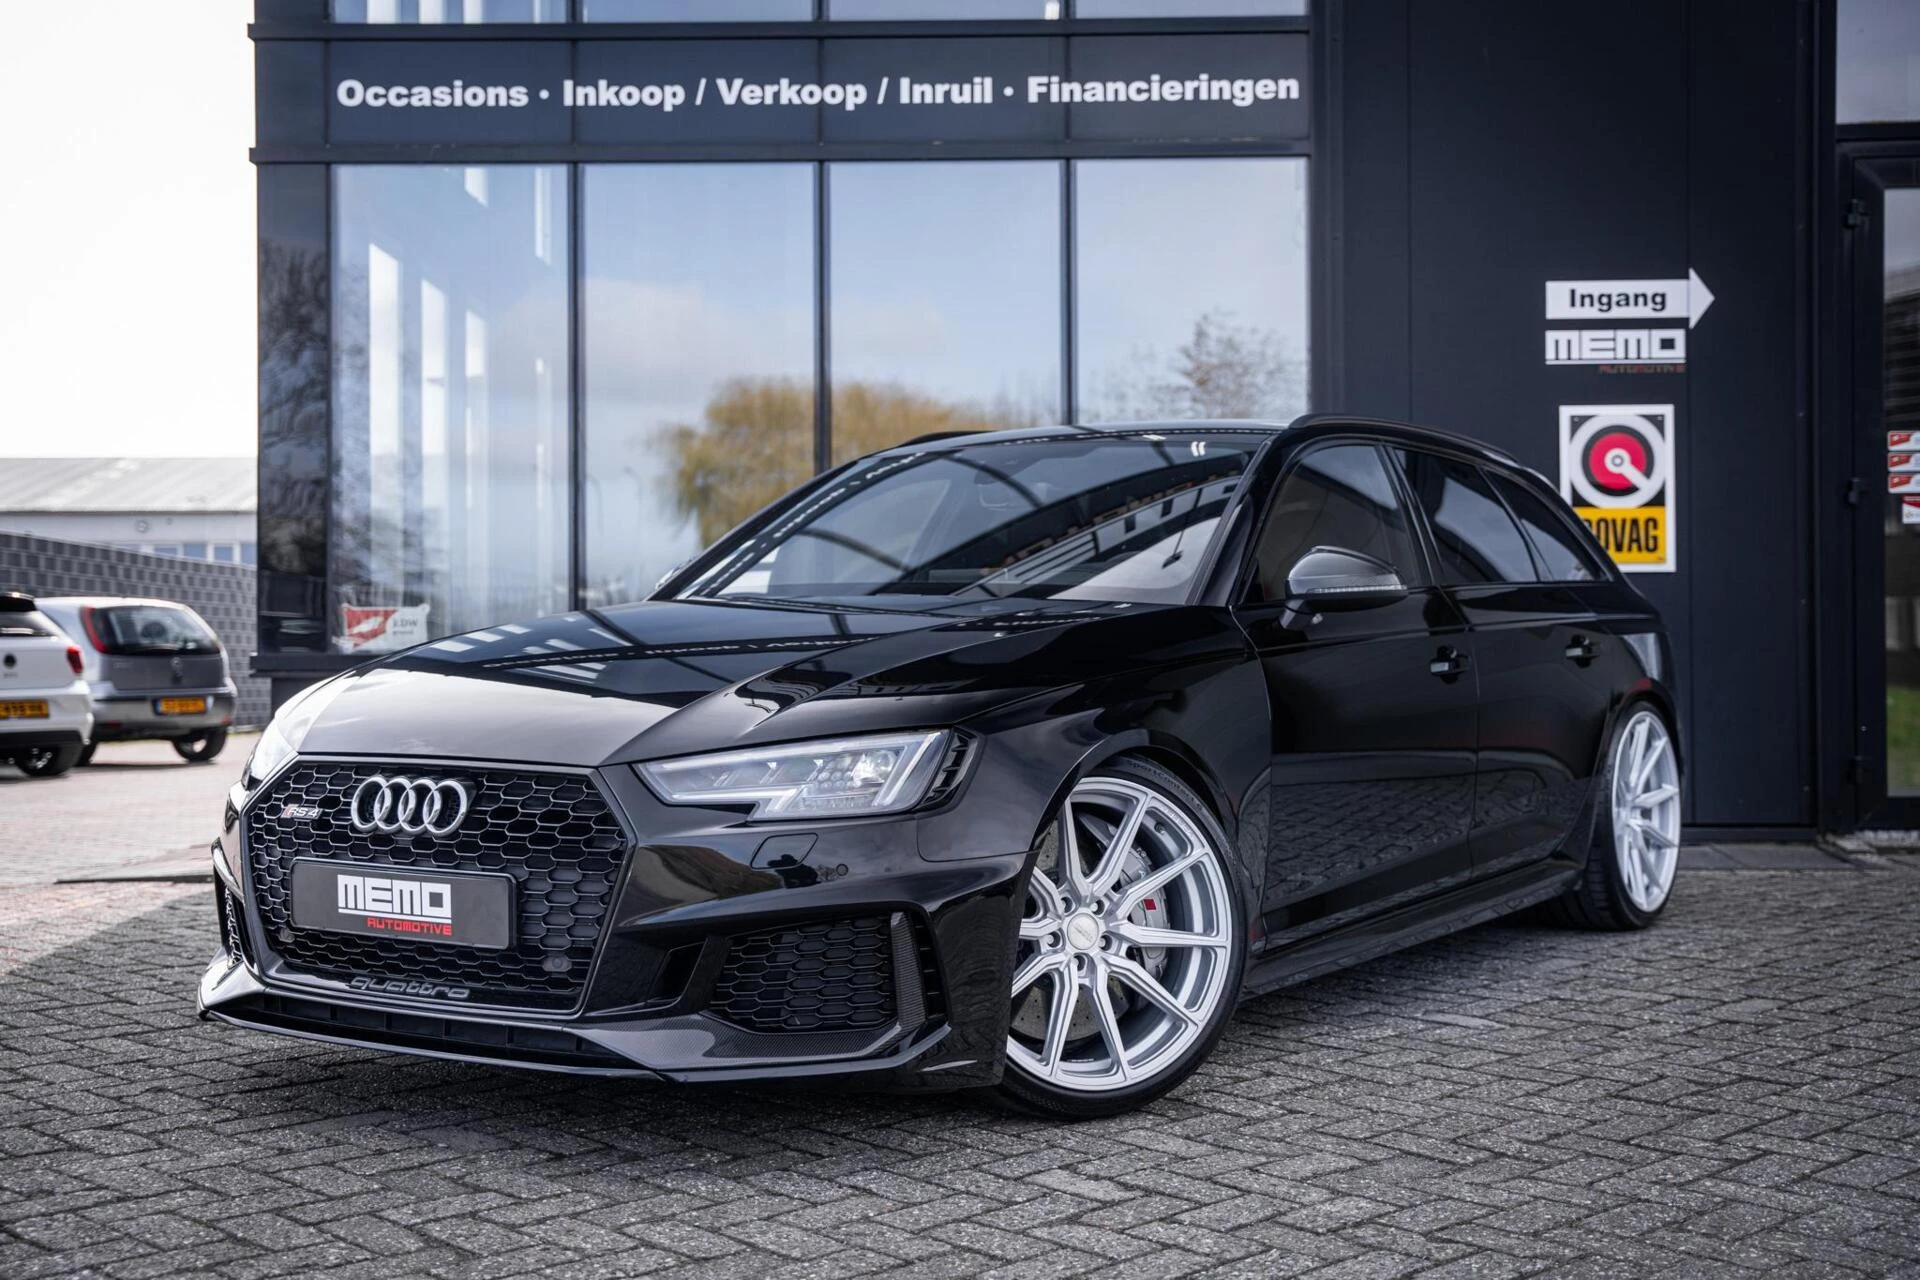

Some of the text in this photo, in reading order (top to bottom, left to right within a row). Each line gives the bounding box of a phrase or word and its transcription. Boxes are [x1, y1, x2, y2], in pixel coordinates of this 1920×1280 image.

[338, 79, 529, 107] Occasions
[563, 79, 686, 112] Inkoop
[716, 78, 868, 111] Verkoop
[899, 76, 993, 104] Inruil
[1027, 73, 1300, 107] Financieringen
[1569, 288, 1668, 313] Ingang
[1545, 329, 1686, 362] MEMO
[1584, 516, 1659, 553] OVAG
[338, 874, 452, 919] MEMO
[366, 917, 453, 936] AUTOMOTIVE
[351, 976, 470, 998] quattro
